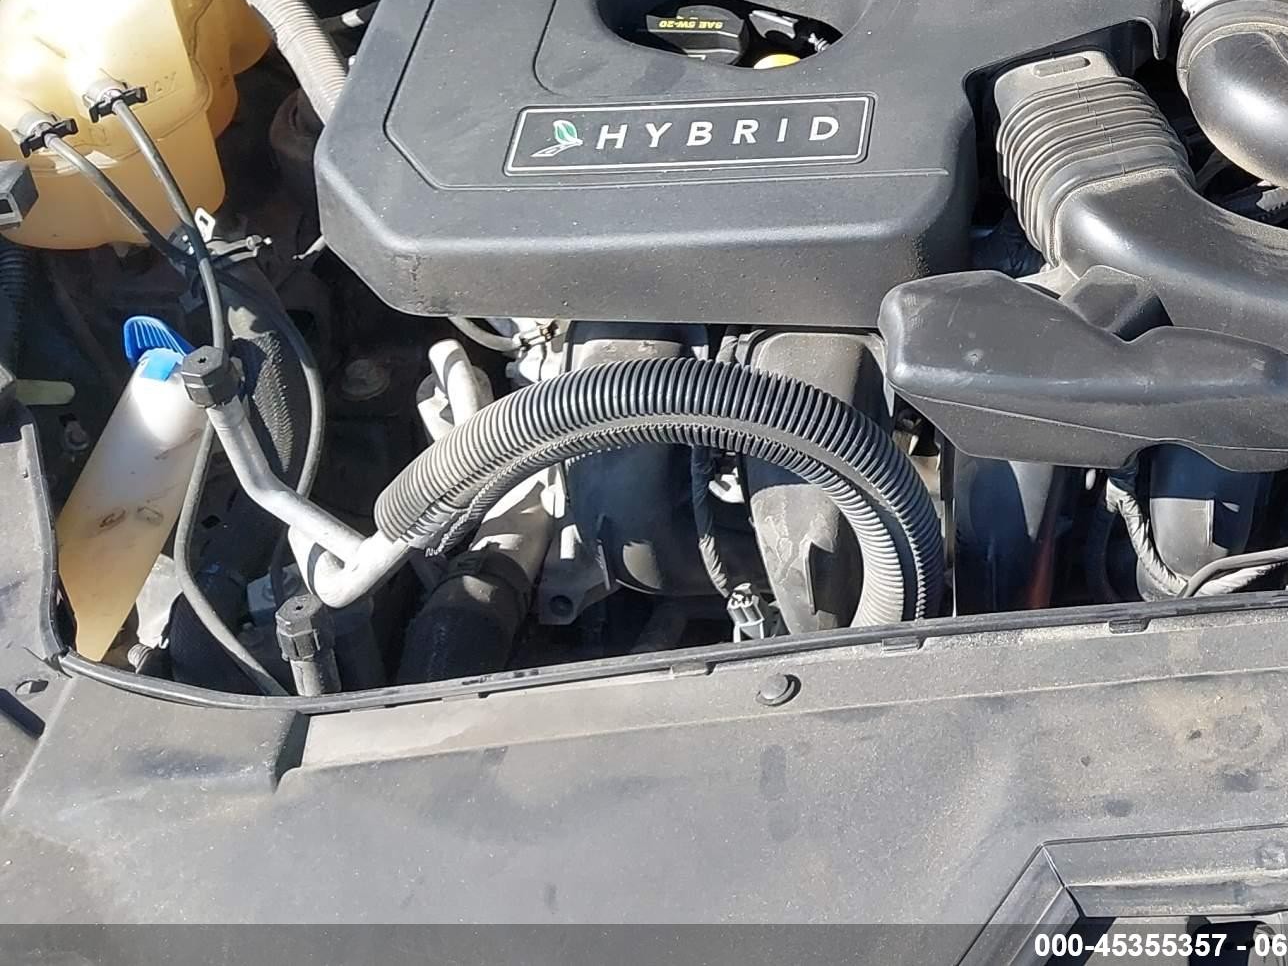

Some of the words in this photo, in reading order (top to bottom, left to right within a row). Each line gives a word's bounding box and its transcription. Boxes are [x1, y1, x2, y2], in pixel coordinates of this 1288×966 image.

[658, 20, 697, 29] 5W-20
[697, 21, 724, 30] SAE
[597, 115, 840, 150] HYBRID
